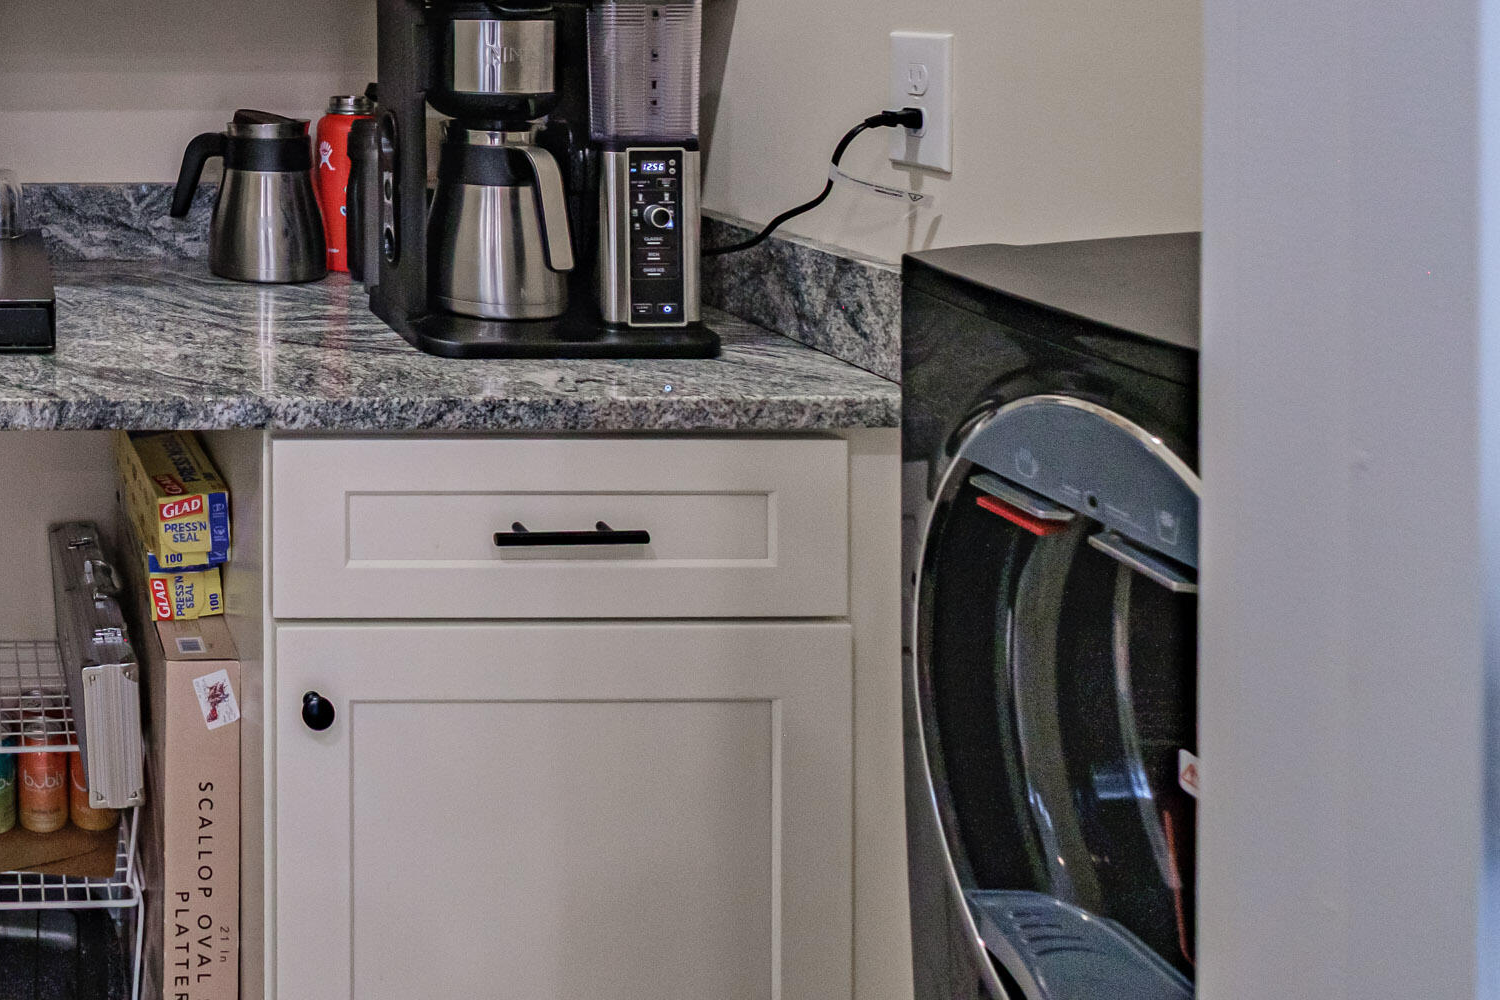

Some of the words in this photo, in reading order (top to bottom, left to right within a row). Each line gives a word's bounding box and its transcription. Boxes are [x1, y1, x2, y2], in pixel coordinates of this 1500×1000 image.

[161, 498, 201, 520] GLAD
[164, 521, 207, 533] PRESS'N
[172, 533, 200, 543] SEAL
[164, 553, 183, 563] 100
[154, 580, 172, 619] GLAD
[176, 575, 186, 617] PRESS'N
[185, 583, 194, 609] SEAL
[209, 592, 220, 612] 100
[198, 781, 213, 898] SCALLOP
[219, 925, 230, 942] 21
[197, 914, 212, 983] OVAL
